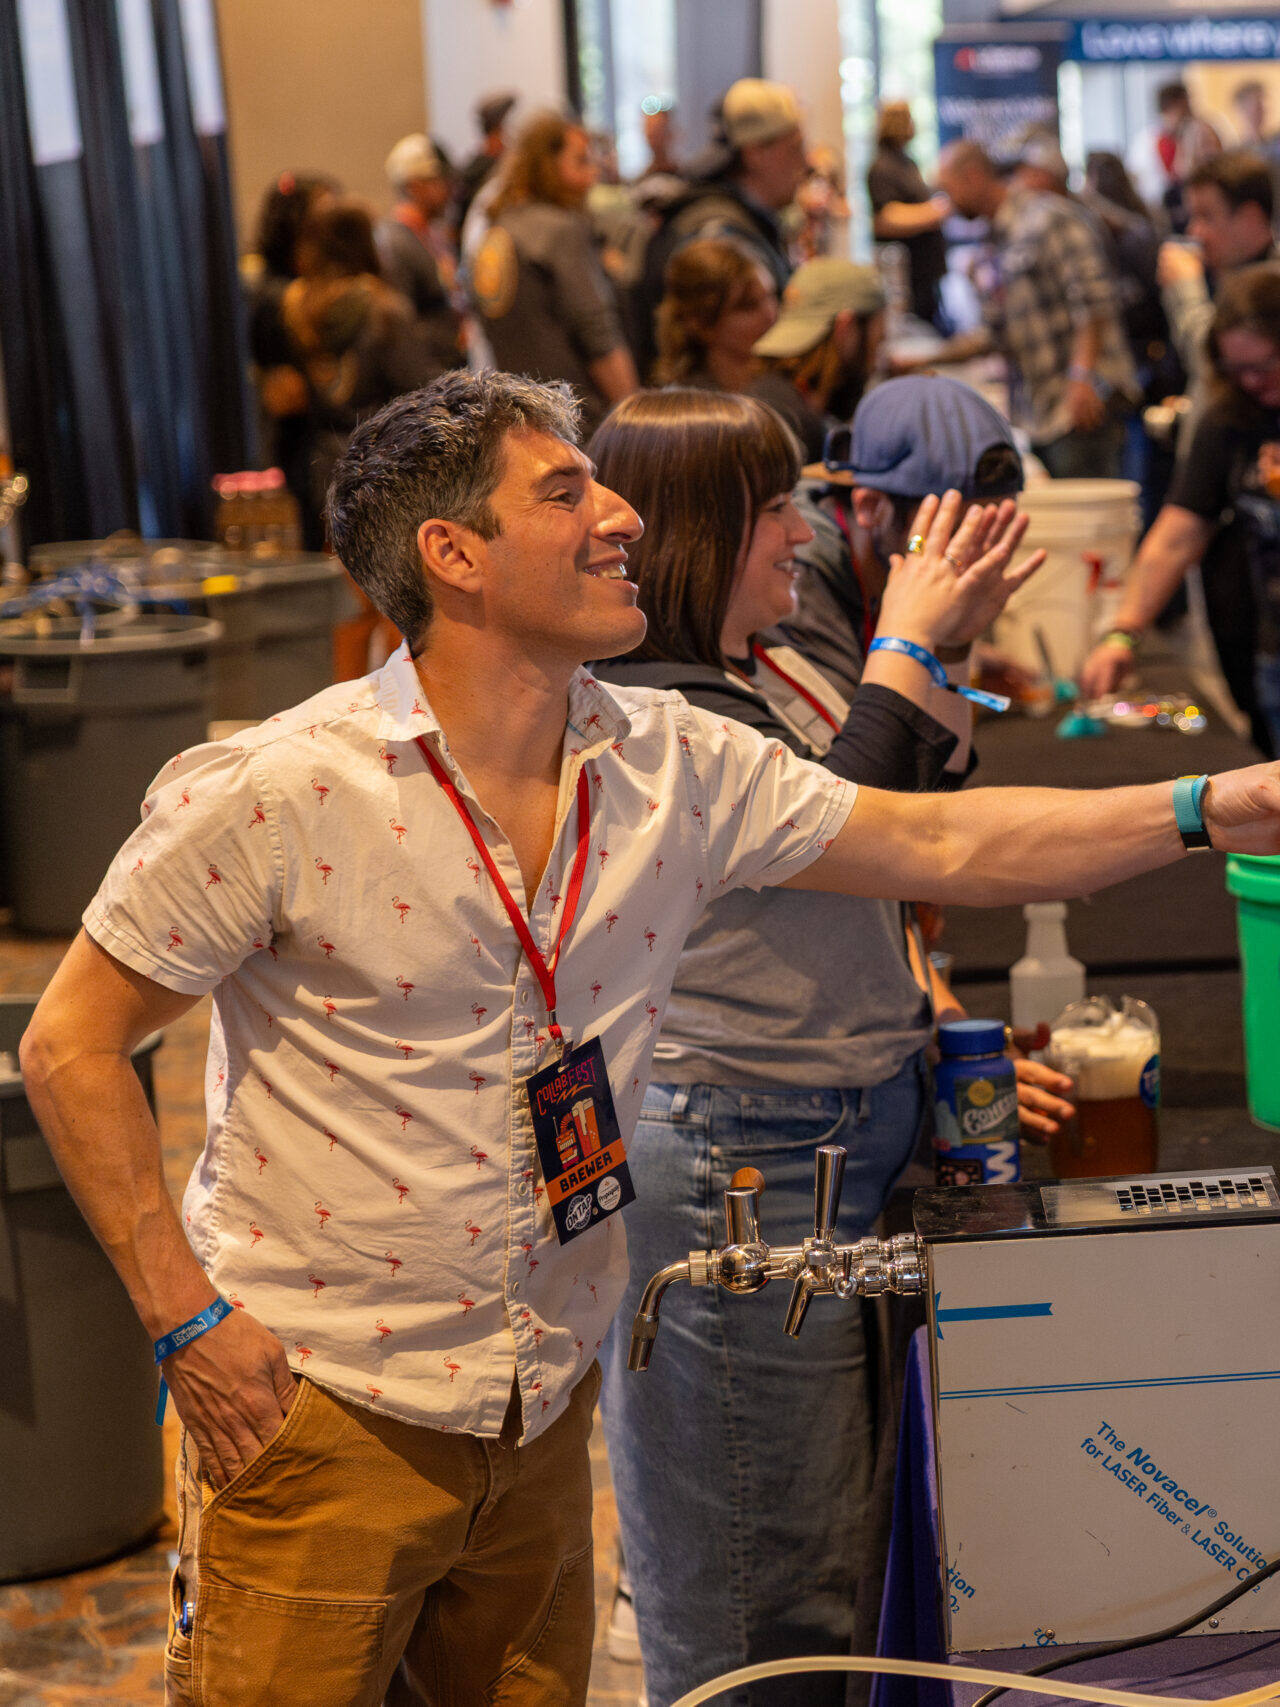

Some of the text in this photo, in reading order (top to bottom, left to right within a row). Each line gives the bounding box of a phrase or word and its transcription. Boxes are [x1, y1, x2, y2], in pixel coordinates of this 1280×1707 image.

[1082, 21, 1167, 58] Love
[1168, 17, 1274, 57] where
[537, 1057, 597, 1116] COLLABFEST
[559, 1151, 613, 1194] BREWER
[1080, 1437, 1105, 1461] for
[1101, 1456, 1148, 1498] LASER
[1146, 1492, 1184, 1526] Fiber
[1181, 1523, 1192, 1535] &
[1190, 1530, 1238, 1572] LASER
[1097, 1421, 1127, 1453] The
[1213, 1521, 1275, 1578] Solutio
